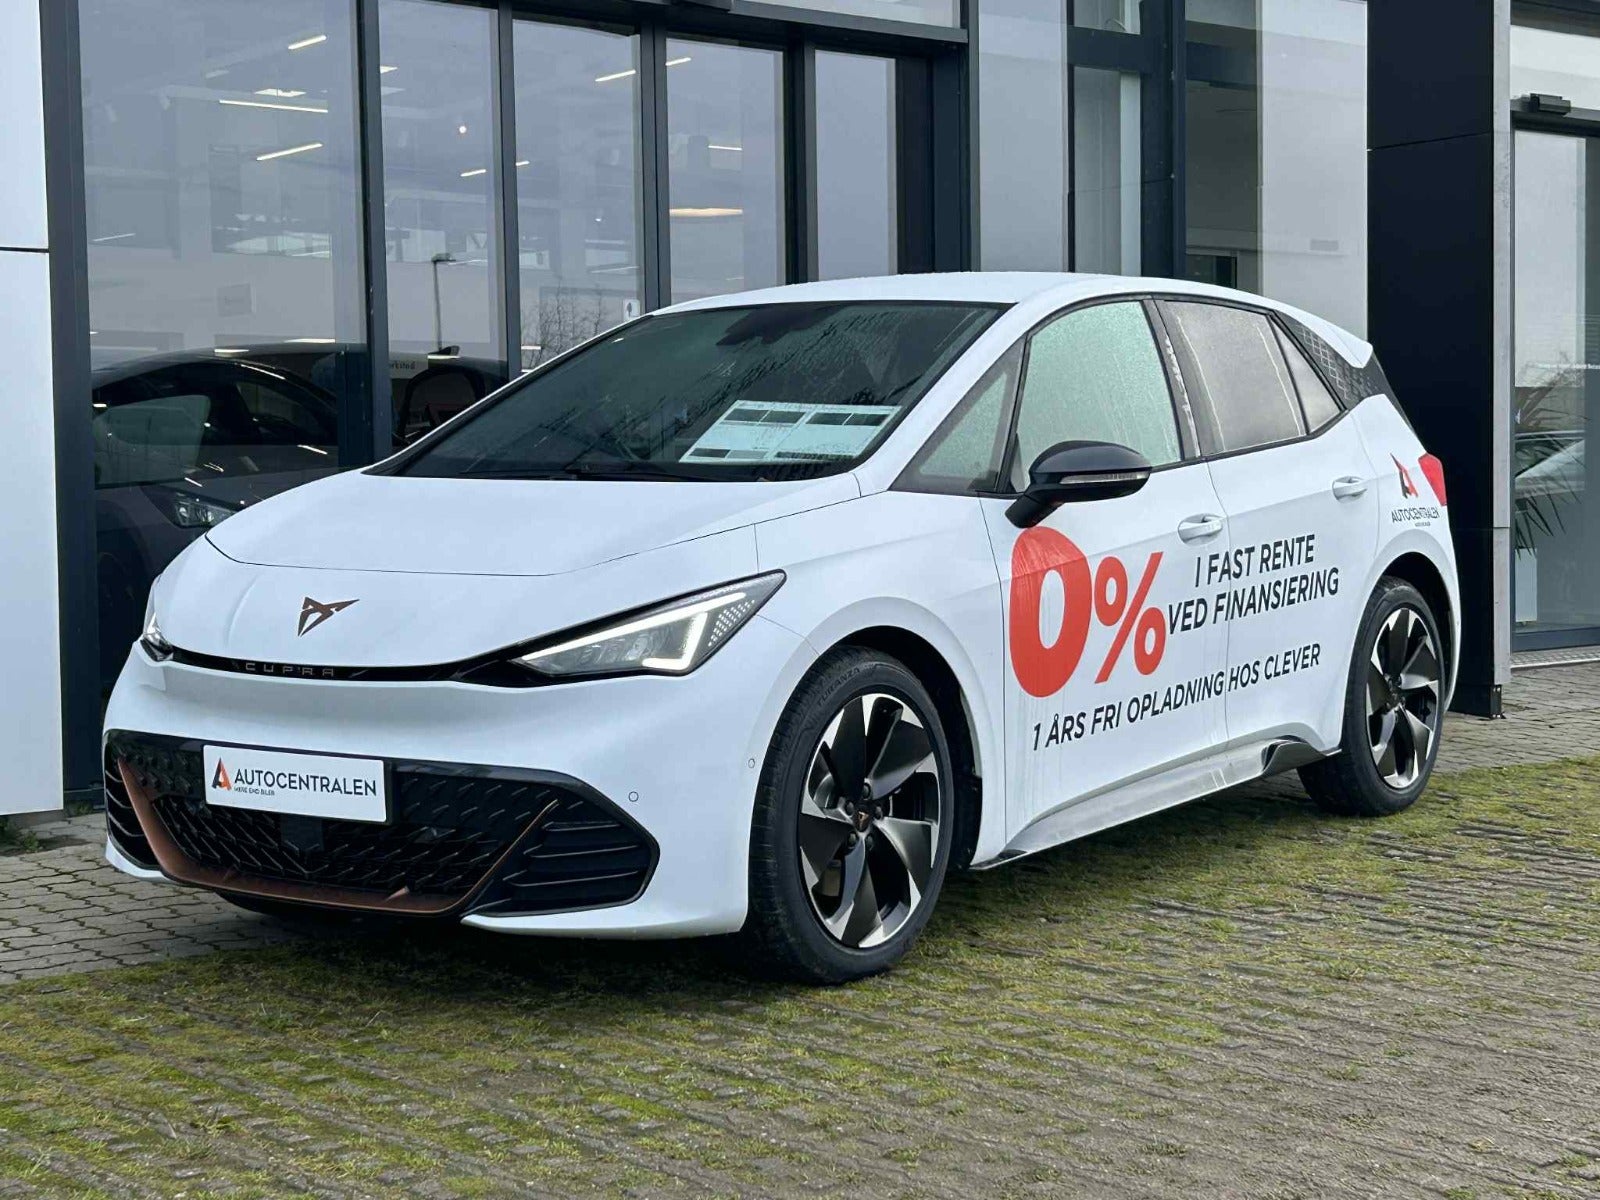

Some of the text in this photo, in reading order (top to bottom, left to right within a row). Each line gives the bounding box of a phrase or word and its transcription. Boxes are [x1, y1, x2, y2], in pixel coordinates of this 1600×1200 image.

[1195, 534, 1316, 588] I FAST RENTE
[1009, 525, 1166, 698] 0%
[1168, 567, 1339, 635] VED FINANSIERING
[245, 662, 335, 677] CUPRA
[1033, 643, 1321, 750] 1 ÅRS FRI OPLADNING HOS CLEVER
[234, 768, 377, 797] AUTOCENTRALEN
